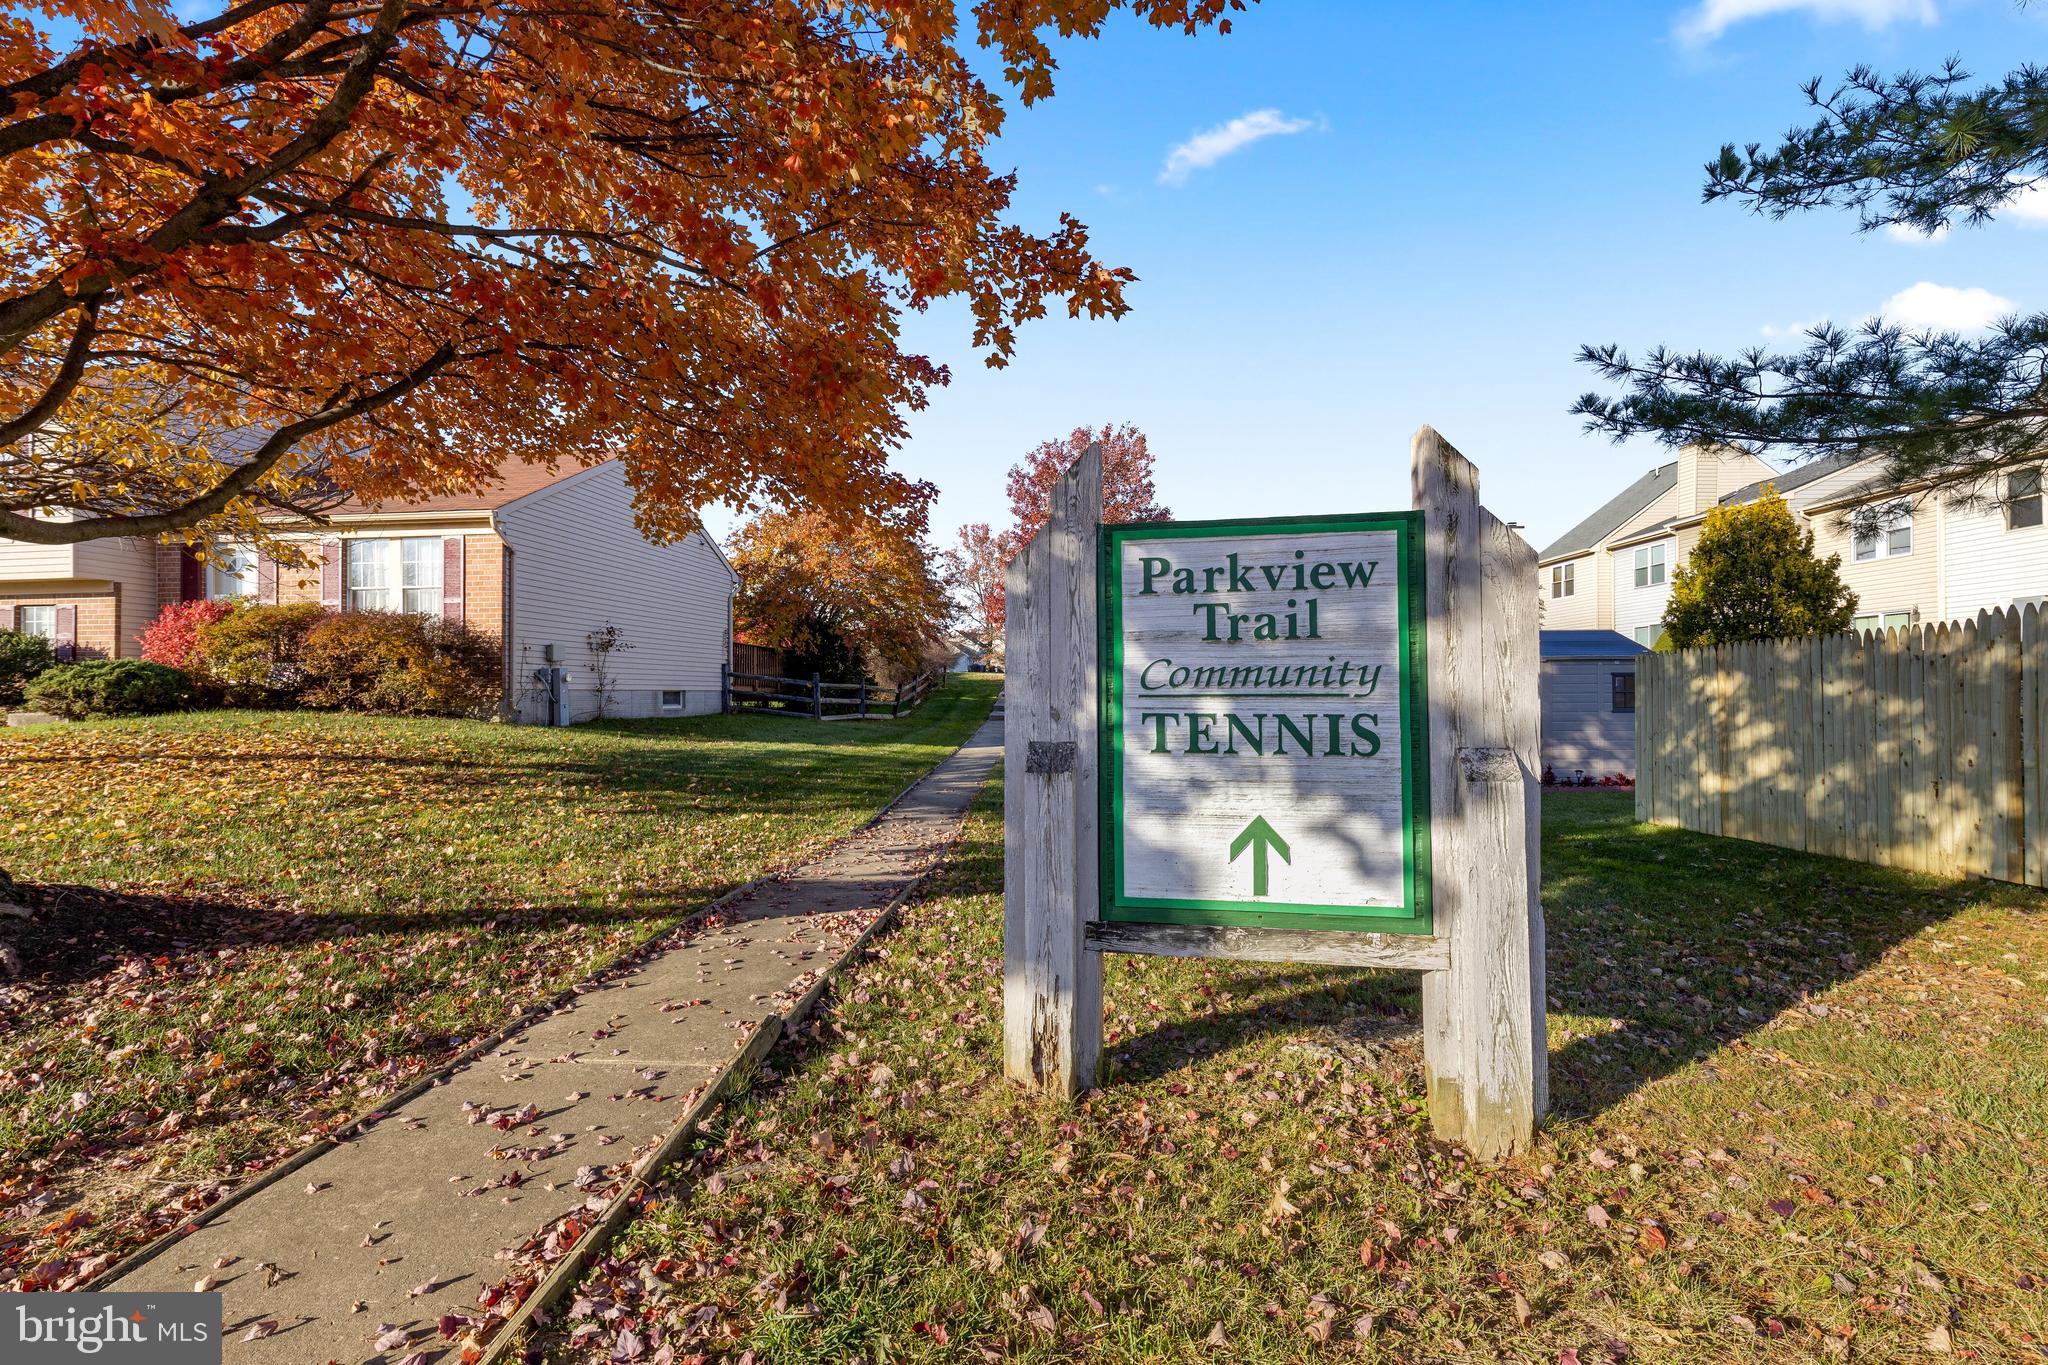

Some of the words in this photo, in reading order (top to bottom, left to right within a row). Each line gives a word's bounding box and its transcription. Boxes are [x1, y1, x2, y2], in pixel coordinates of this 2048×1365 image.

[1138, 550, 1379, 595] Parkview
[1193, 599, 1322, 642] Trail
[1139, 656, 1382, 698] Community
[1141, 711, 1382, 758] TENNIS
